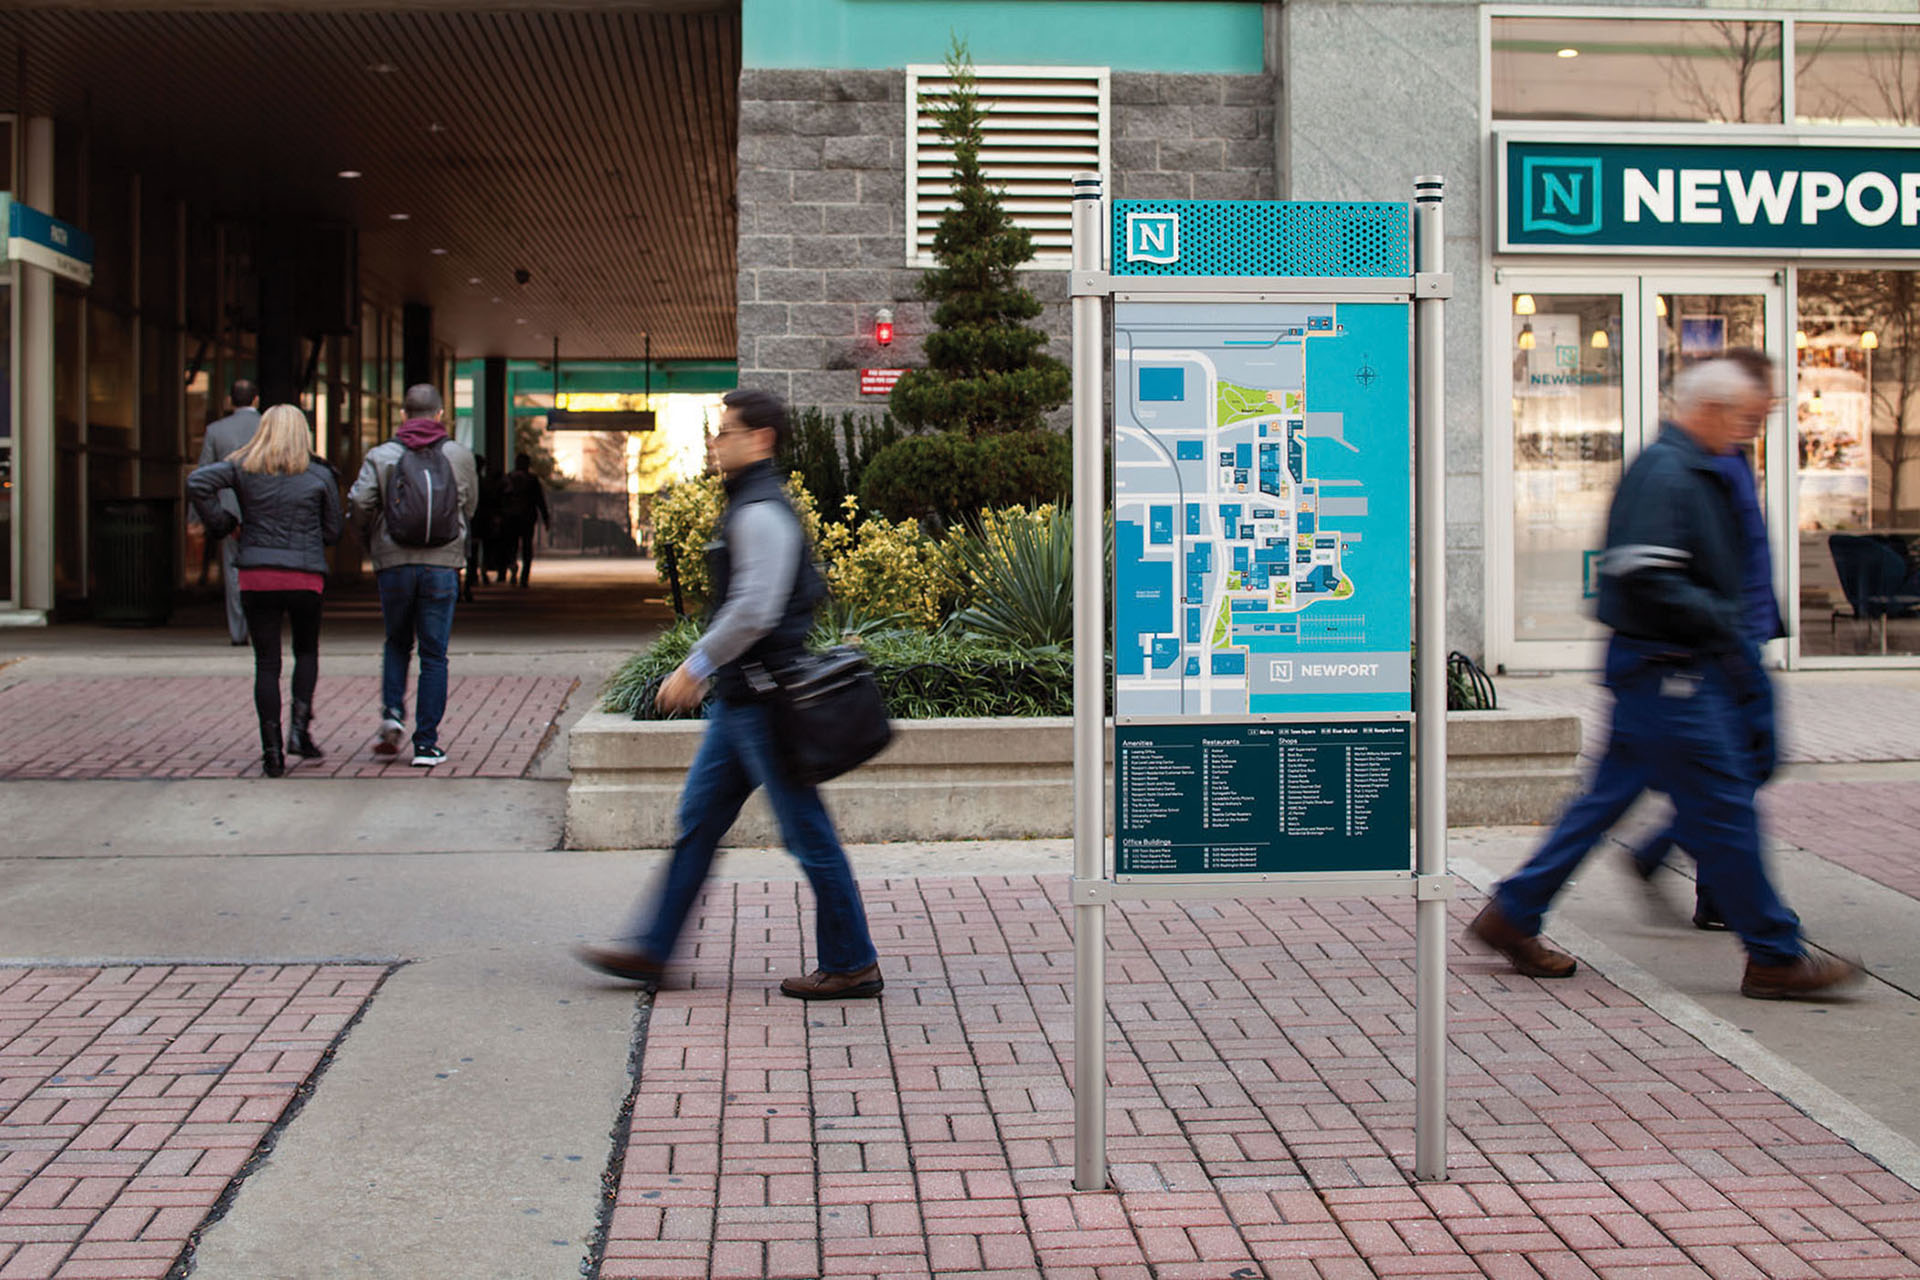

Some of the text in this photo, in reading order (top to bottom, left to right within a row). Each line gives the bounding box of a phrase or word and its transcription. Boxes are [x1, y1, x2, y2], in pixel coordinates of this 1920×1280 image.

[1542, 172, 1584, 215] N
[1138, 223, 1167, 251] N
[1276, 664, 1379, 677] N NEWPORT
